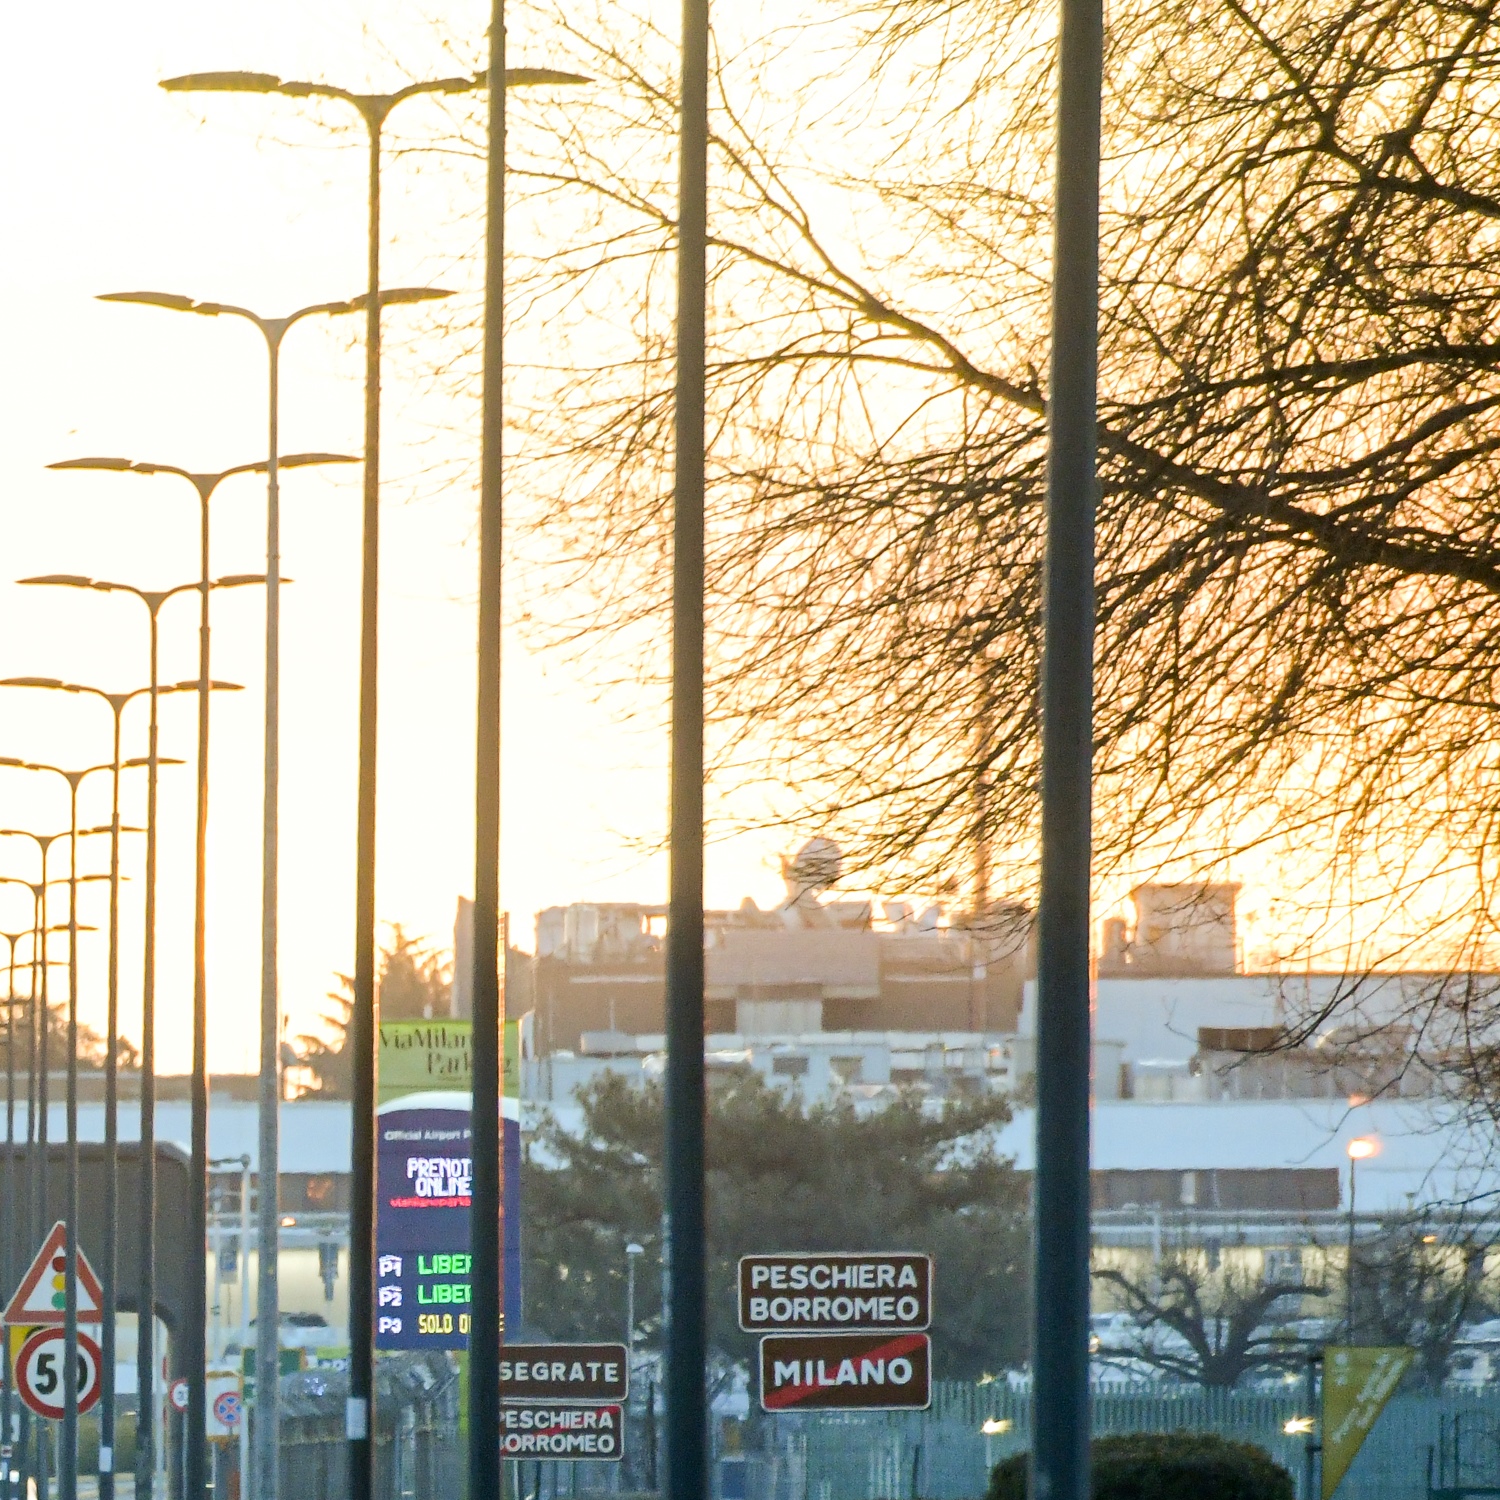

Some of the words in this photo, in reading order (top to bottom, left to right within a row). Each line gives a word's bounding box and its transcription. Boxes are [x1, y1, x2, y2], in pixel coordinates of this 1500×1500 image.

[380, 1027, 472, 1048] ViaMilan
[407, 1157, 472, 1179] PRENOT
[415, 1177, 472, 1196] ONLINE
[379, 1258, 402, 1277] P1
[751, 1264, 918, 1289] PESCHIERA
[379, 1289, 402, 1306] P2
[749, 1296, 919, 1321] BORROMEO
[379, 1317, 402, 1333] P3
[419, 1314, 453, 1334] SOLO
[499, 1361, 619, 1382] SEGRATE
[773, 1357, 913, 1386] MILANO
[500, 1433, 615, 1453] ORROMEO
